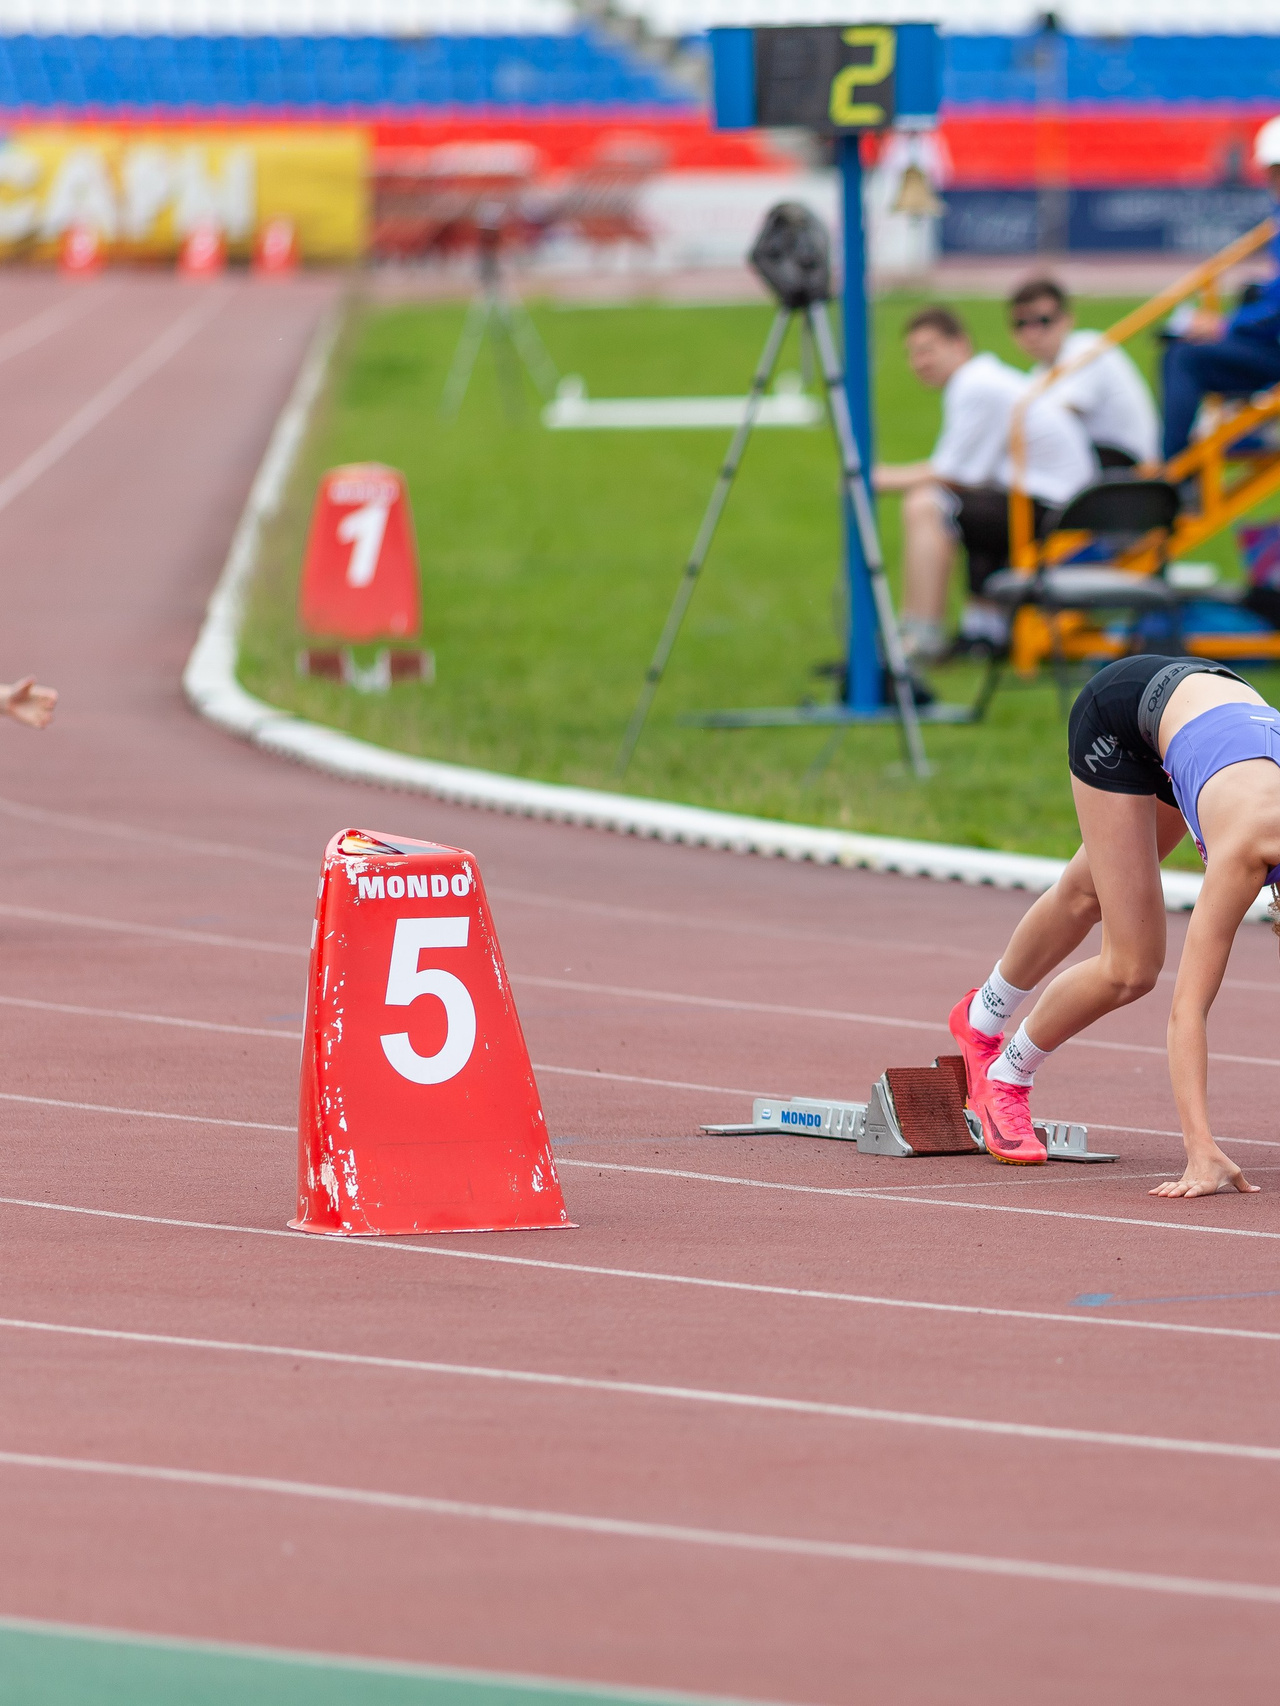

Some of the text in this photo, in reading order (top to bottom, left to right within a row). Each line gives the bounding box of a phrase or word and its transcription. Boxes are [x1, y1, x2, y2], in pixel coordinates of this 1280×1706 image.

[829, 26, 896, 126] 2
[336, 502, 391, 588] 1
[357, 874, 470, 900] MONDO
[379, 916, 477, 1085] 5
[781, 1110, 822, 1128] MONDO
